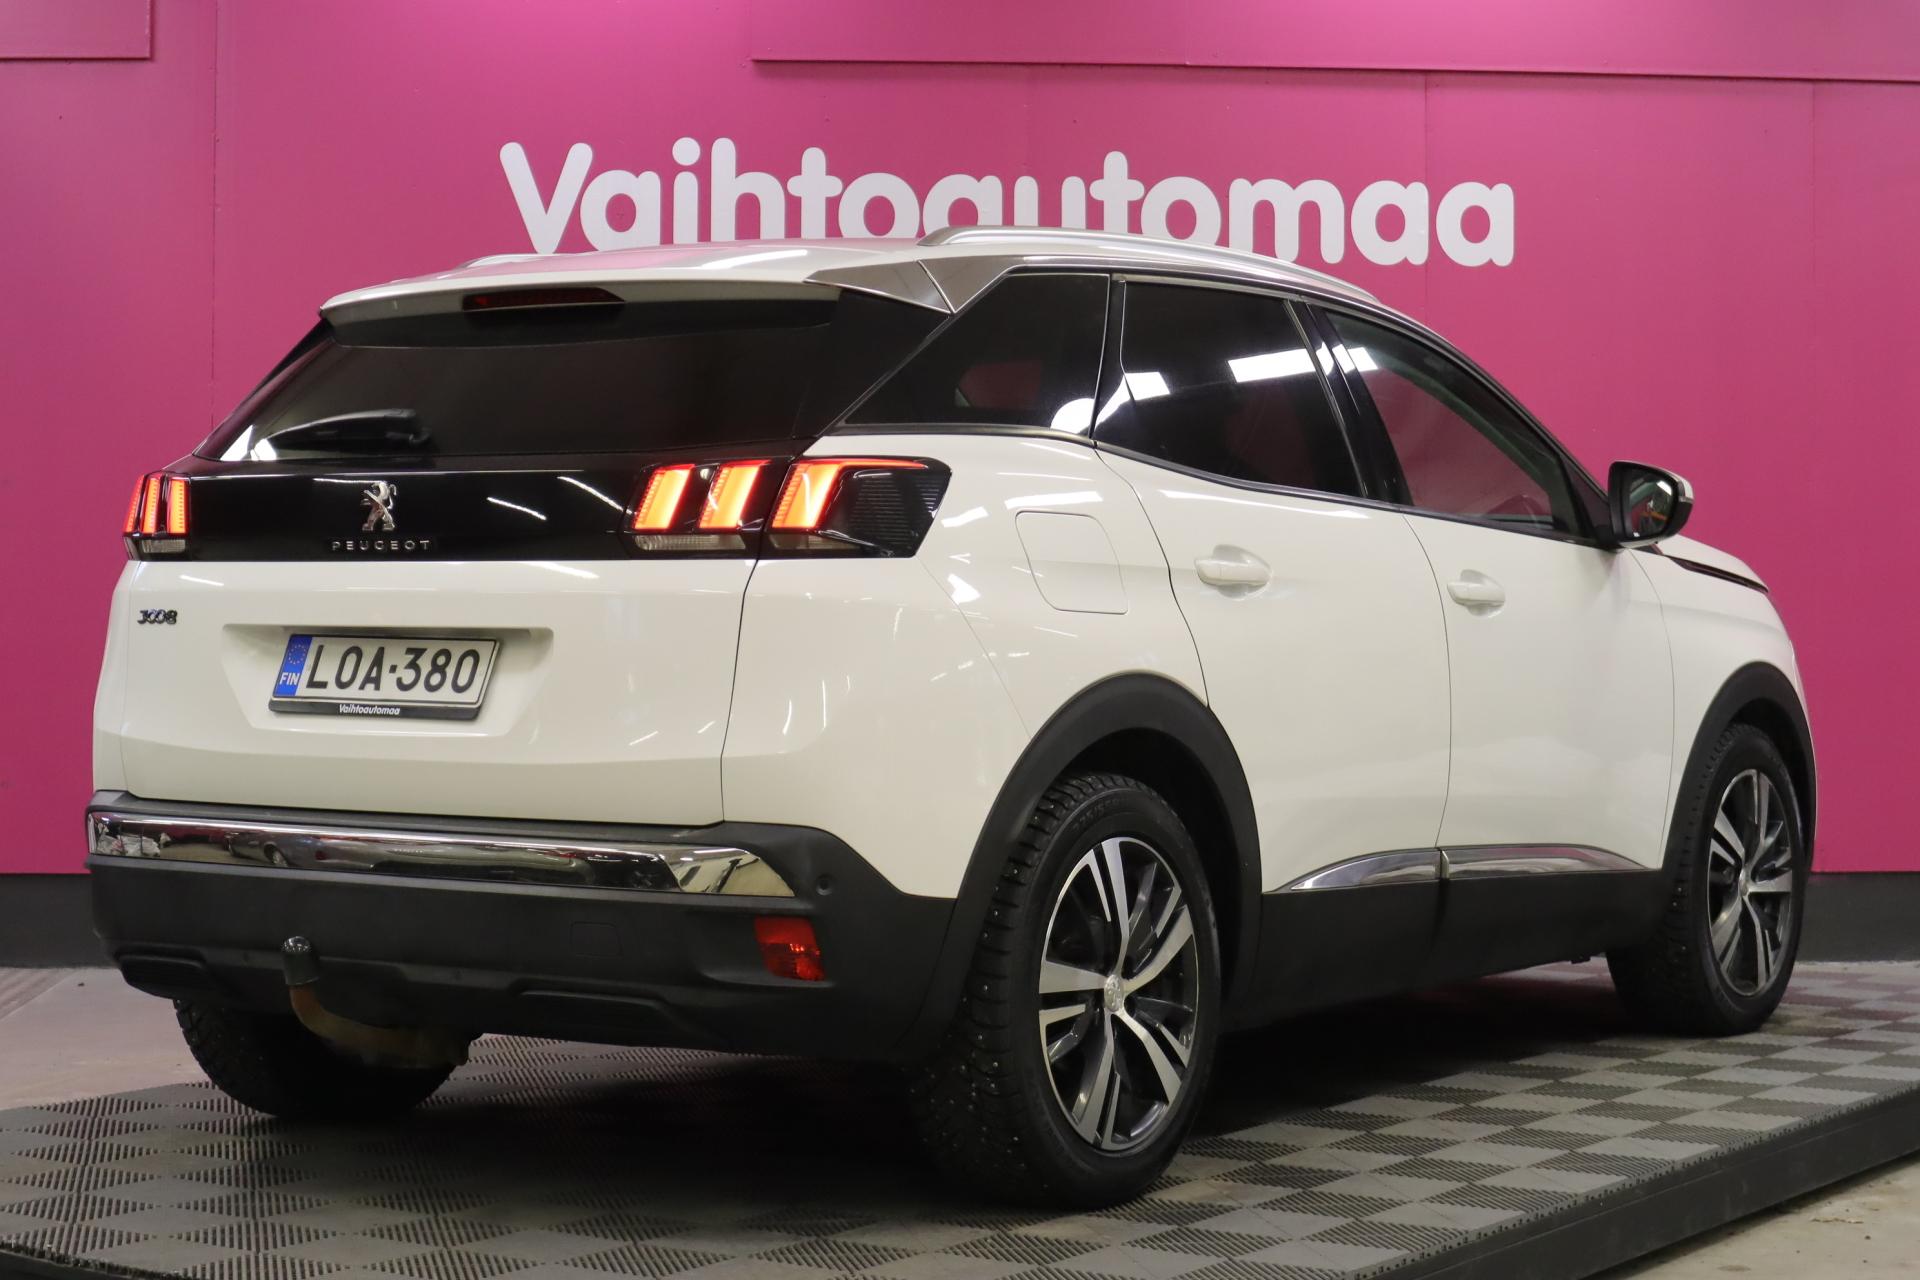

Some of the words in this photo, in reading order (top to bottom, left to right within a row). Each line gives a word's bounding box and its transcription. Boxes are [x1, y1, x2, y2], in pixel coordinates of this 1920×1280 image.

[498, 136, 1516, 266] Vaihtoautomaa
[331, 540, 430, 551] PEUGEOT
[279, 672, 301, 686] FIN
[338, 704, 401, 716] Vaihtoautomaa
